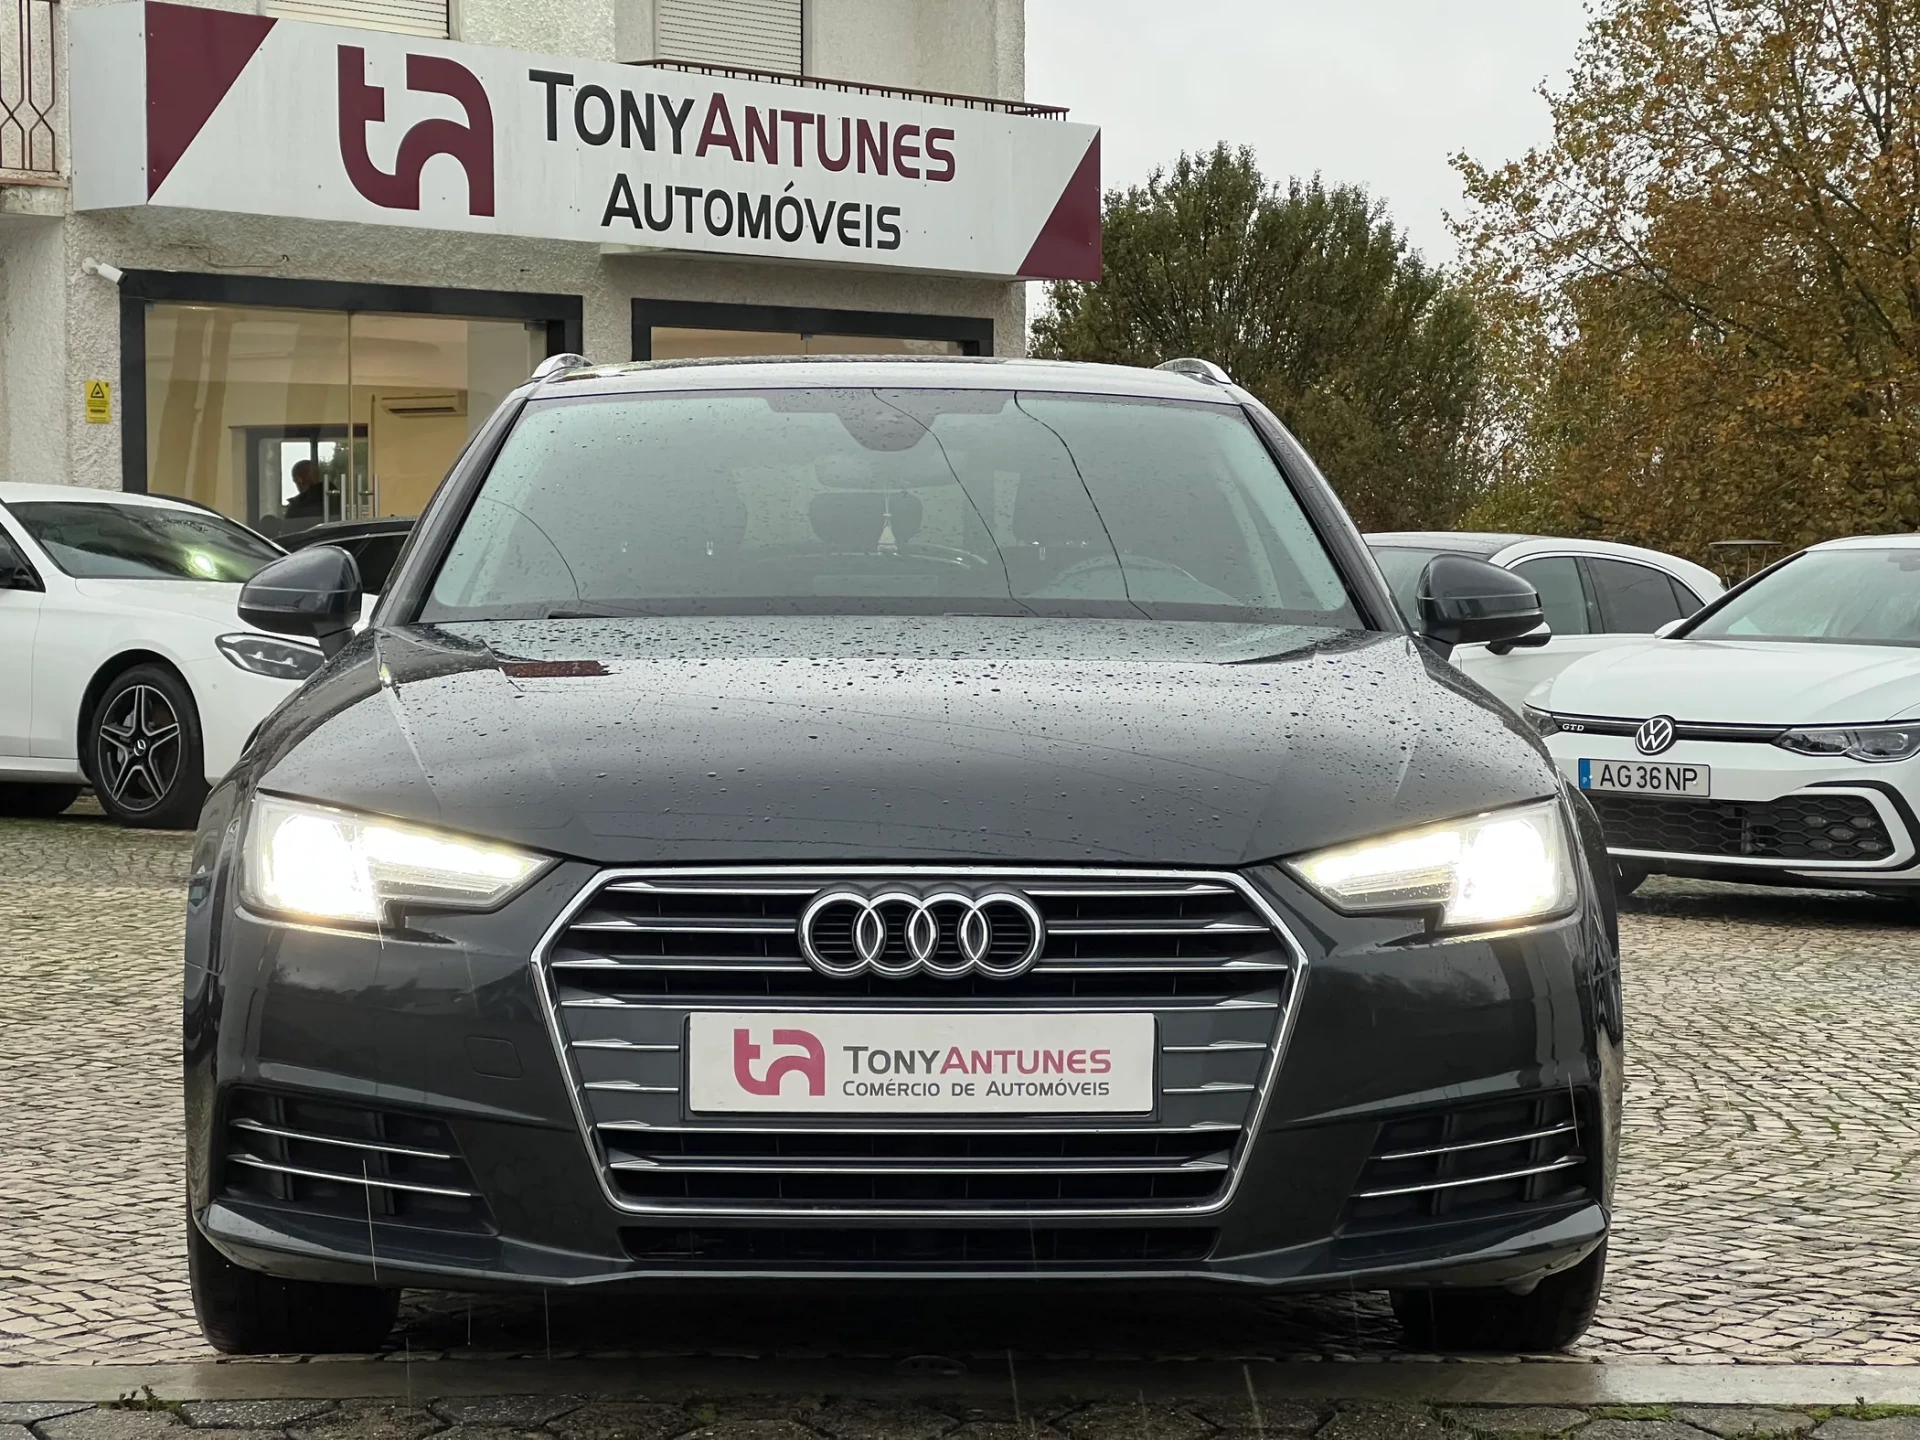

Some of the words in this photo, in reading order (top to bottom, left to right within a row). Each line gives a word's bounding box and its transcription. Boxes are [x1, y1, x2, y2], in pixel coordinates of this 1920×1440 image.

[600, 172, 901, 251] AUTOMÓVEIS
[1562, 723, 1585, 731] GTD
[842, 1078, 941, 1097] COMÉRCIO
[951, 1082, 975, 1097] DE
[985, 1078, 1110, 1097] AUTOMÓVEIS
